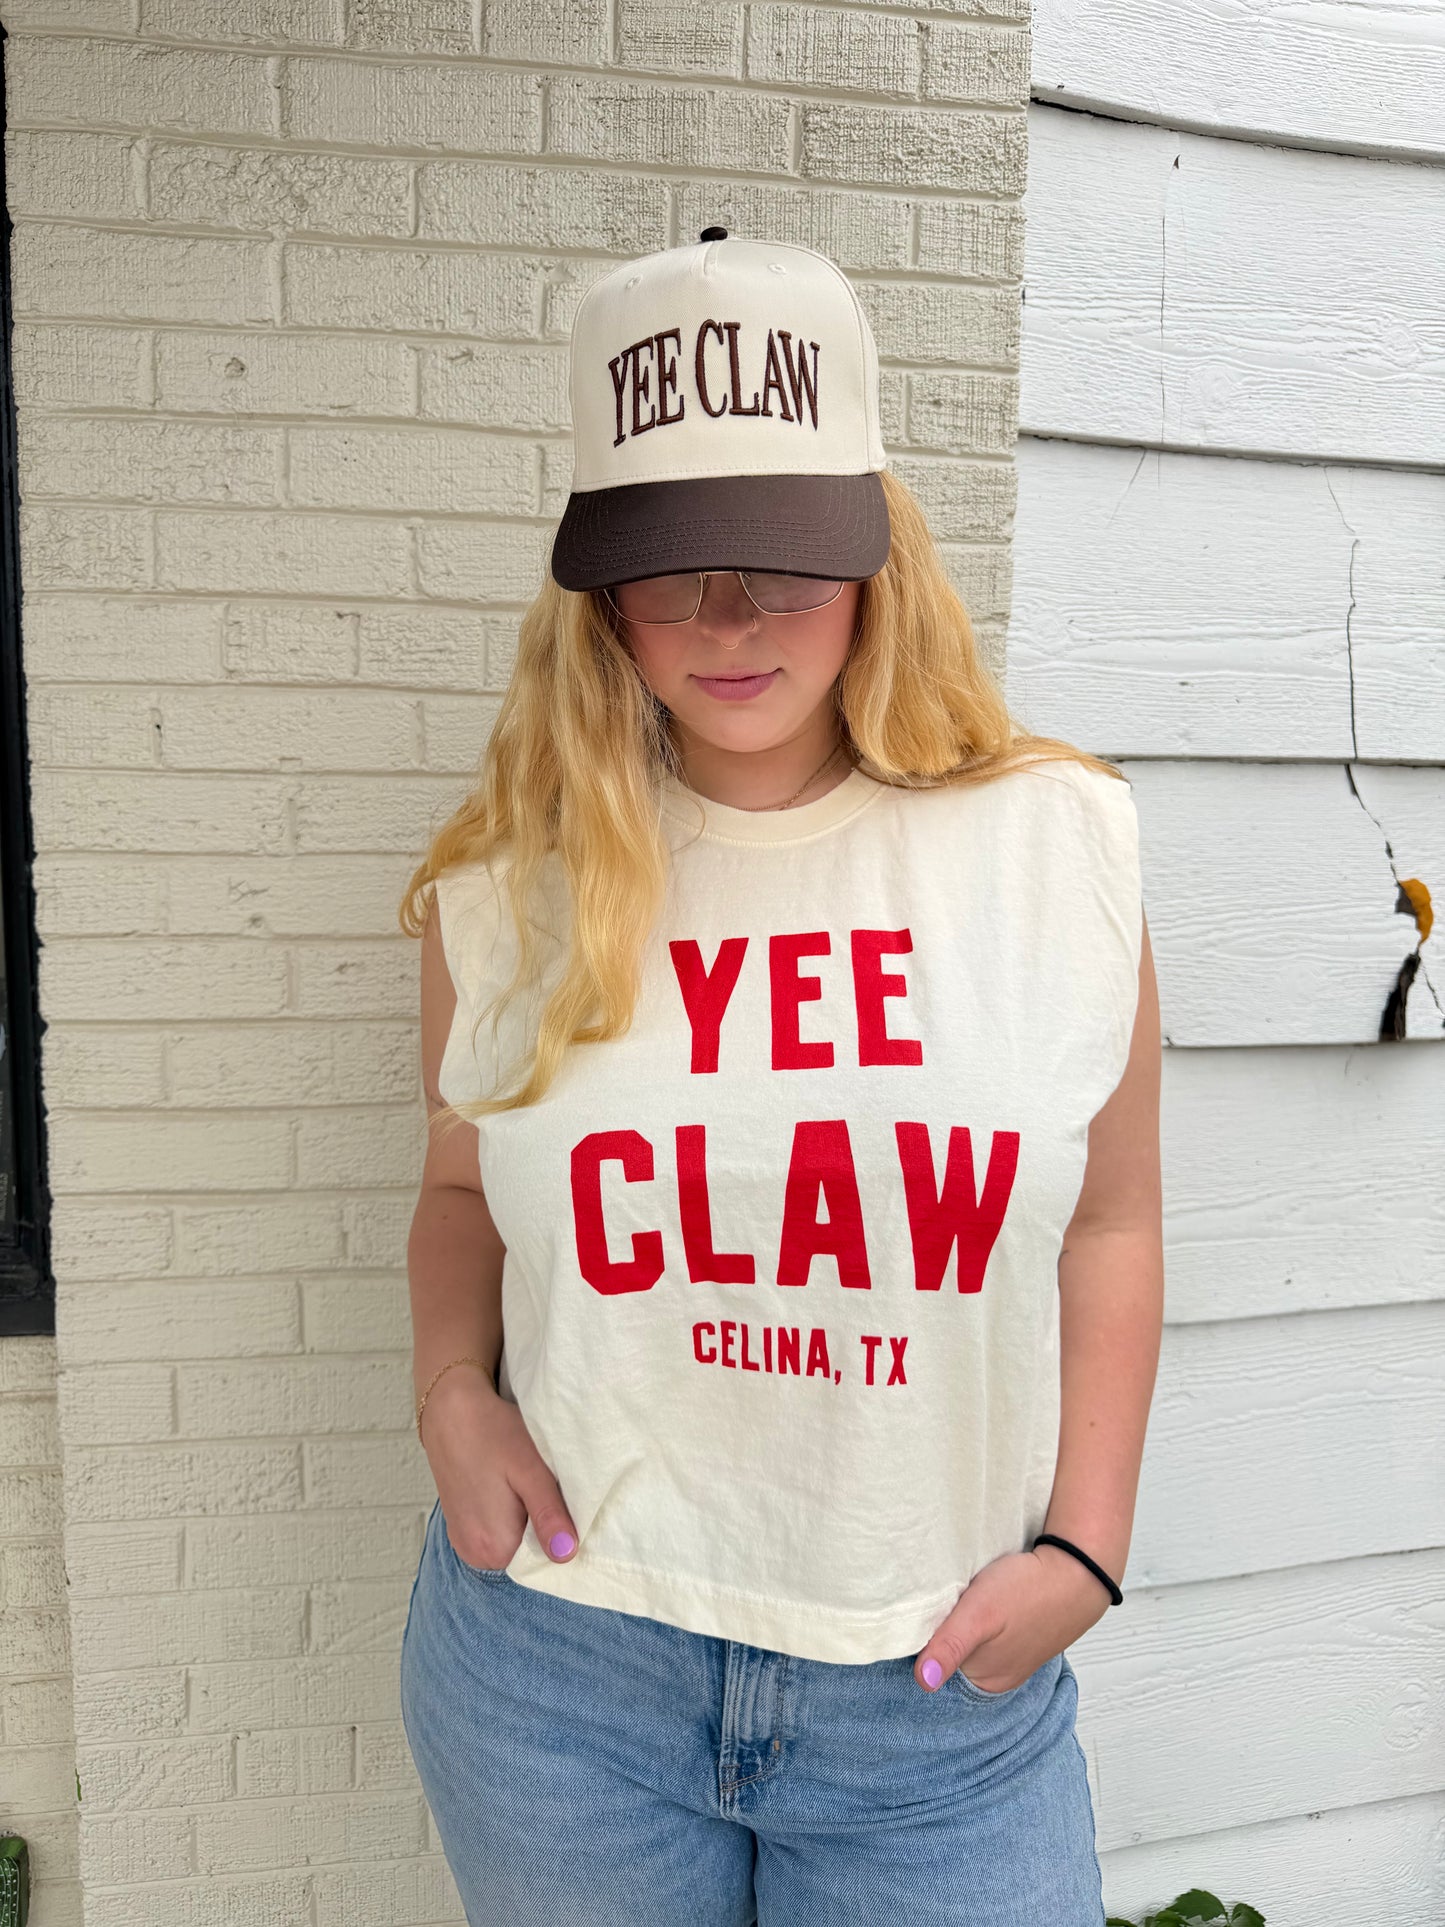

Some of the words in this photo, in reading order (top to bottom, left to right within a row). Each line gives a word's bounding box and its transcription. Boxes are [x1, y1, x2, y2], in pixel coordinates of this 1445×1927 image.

[608, 327, 685, 448] YEE
[695, 319, 820, 431] CLAW
[669, 928, 923, 1073] YEE
[571, 1119, 1020, 1295] CLAW
[692, 1320, 842, 1386] CELINA,
[861, 1336, 908, 1386] TX
